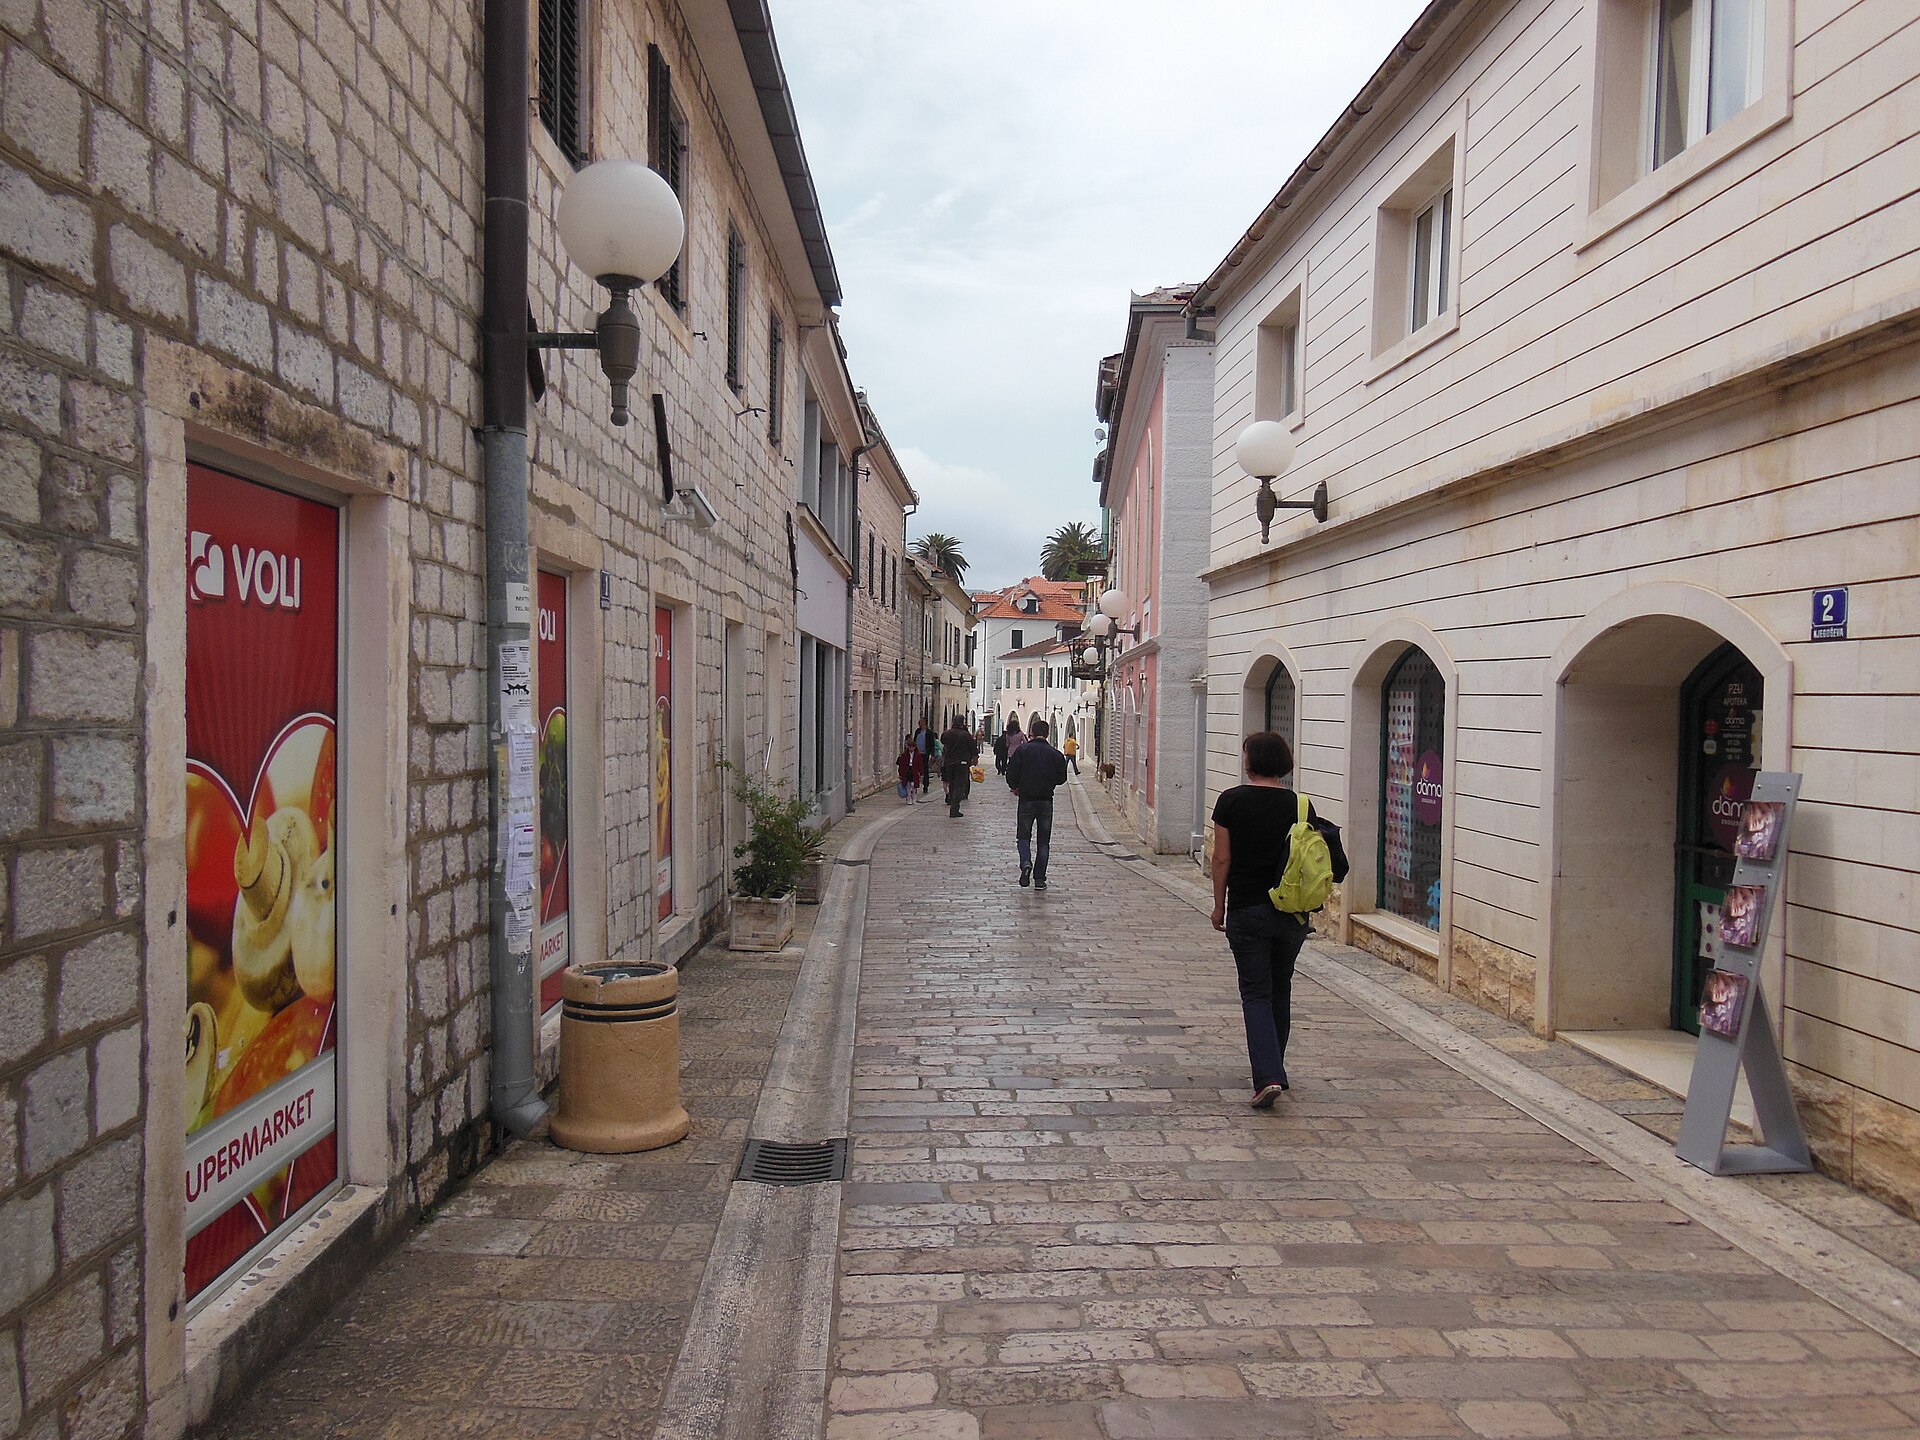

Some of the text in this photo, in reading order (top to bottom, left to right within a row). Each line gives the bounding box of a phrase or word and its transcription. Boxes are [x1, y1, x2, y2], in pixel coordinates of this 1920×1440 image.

[232, 544, 300, 608] VOLI
[1822, 594, 1834, 621] 2
[538, 608, 556, 641] OLI
[1723, 697, 1748, 706] APOTEKA
[1416, 778, 1442, 798] dama
[186, 1089, 314, 1203] UPERMARKET
